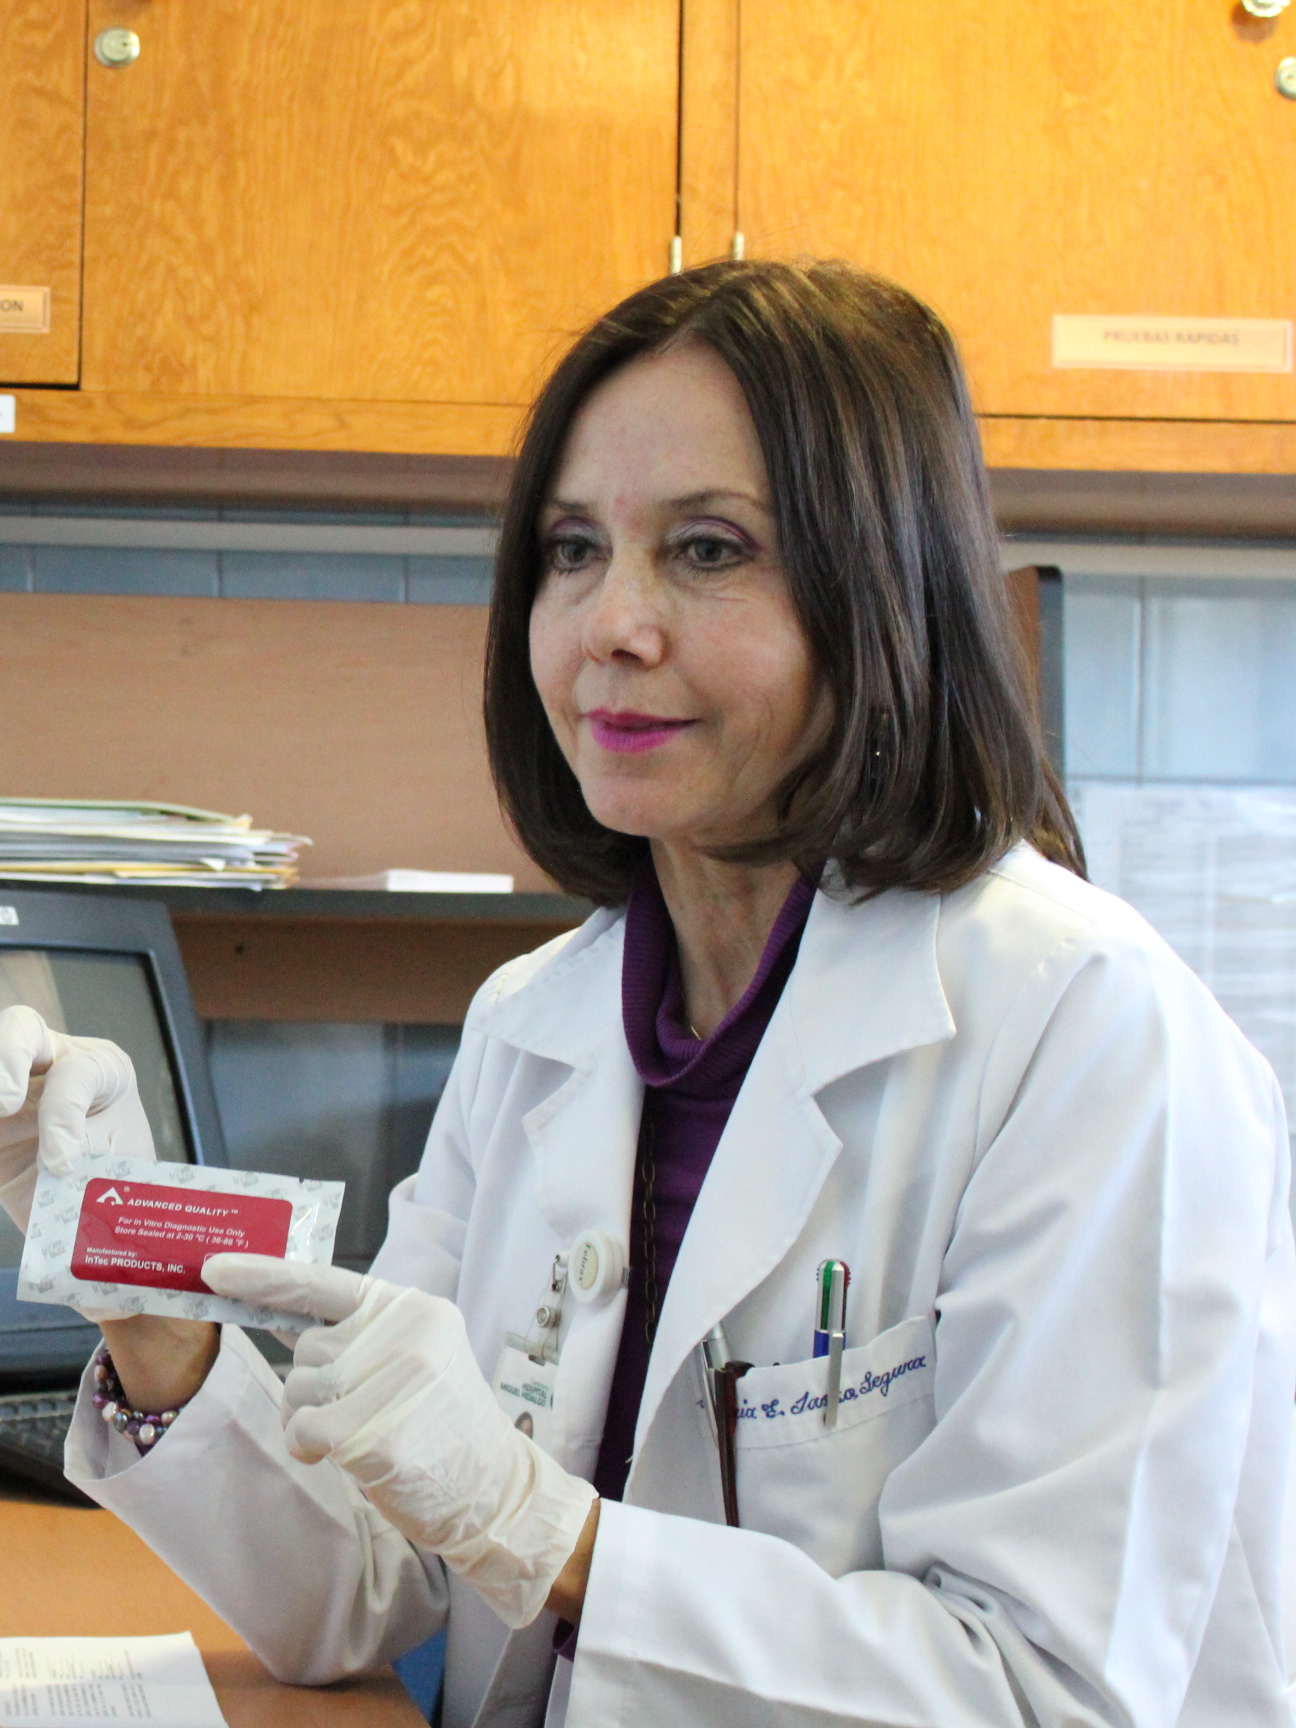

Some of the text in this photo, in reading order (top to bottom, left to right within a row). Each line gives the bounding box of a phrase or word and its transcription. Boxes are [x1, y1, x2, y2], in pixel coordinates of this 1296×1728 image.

[127, 1198, 183, 1211] ADVANCED
[185, 1204, 229, 1217] QUALITY
[114, 1226, 136, 1235] Store
[138, 1228, 165, 1238] Sealed
[166, 1231, 174, 1239] at
[118, 1217, 132, 1225] For
[144, 1219, 162, 1228] Vitro
[164, 1221, 206, 1233] Diagnostic
[209, 1227, 224, 1235] Use
[226, 1228, 245, 1238] Only
[86, 1247, 127, 1256] Manufactured
[85, 1255, 186, 1274] InTec PRODUCTS, INC.
[859, 1356, 926, 1397] Segura
